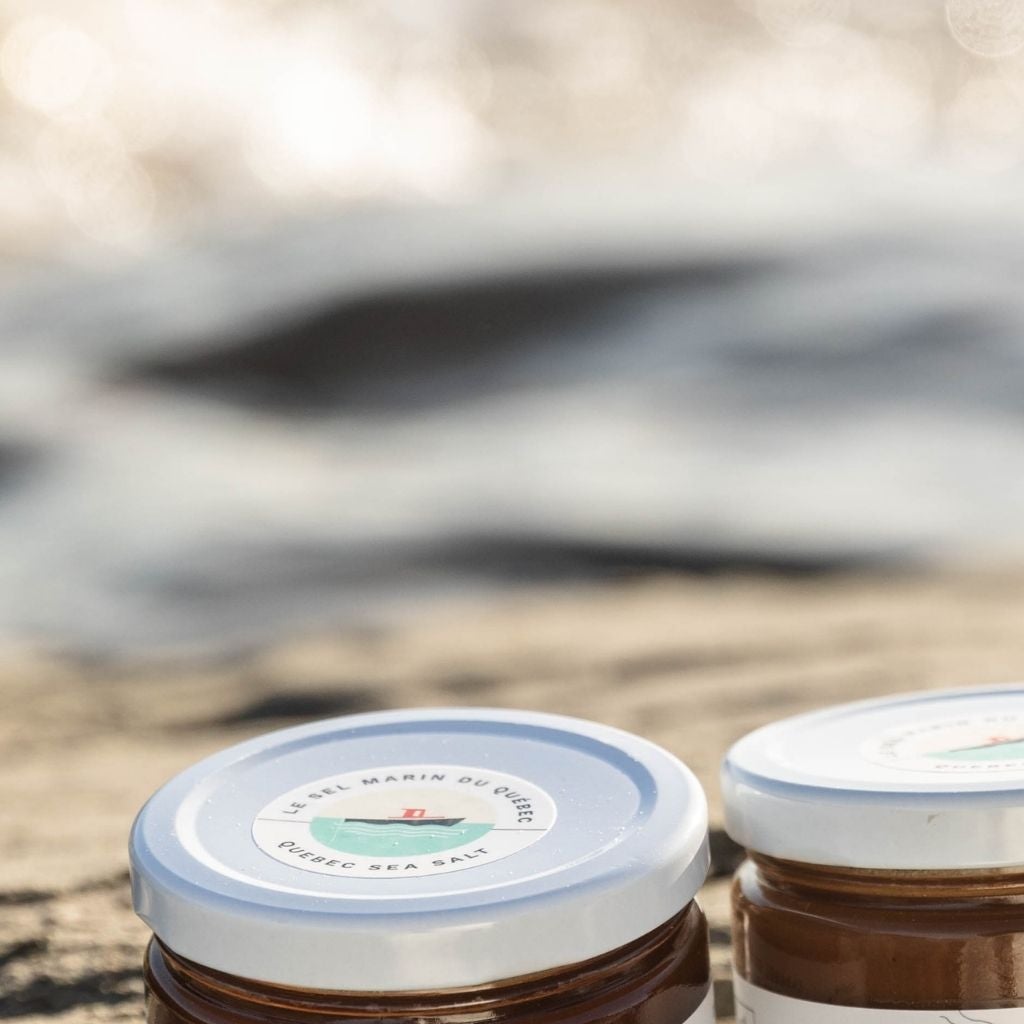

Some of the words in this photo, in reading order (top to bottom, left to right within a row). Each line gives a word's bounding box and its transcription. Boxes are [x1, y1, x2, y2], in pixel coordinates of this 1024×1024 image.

[282, 801, 307, 815] LE
[308, 784, 351, 800] SEL
[361, 774, 446, 786] MARIN
[458, 776, 489, 788] DU
[493, 786, 534, 823] QUÉBEC
[277, 841, 356, 870] QUEBEC
[368, 863, 418, 871] SEA
[432, 847, 488, 867] SALT
